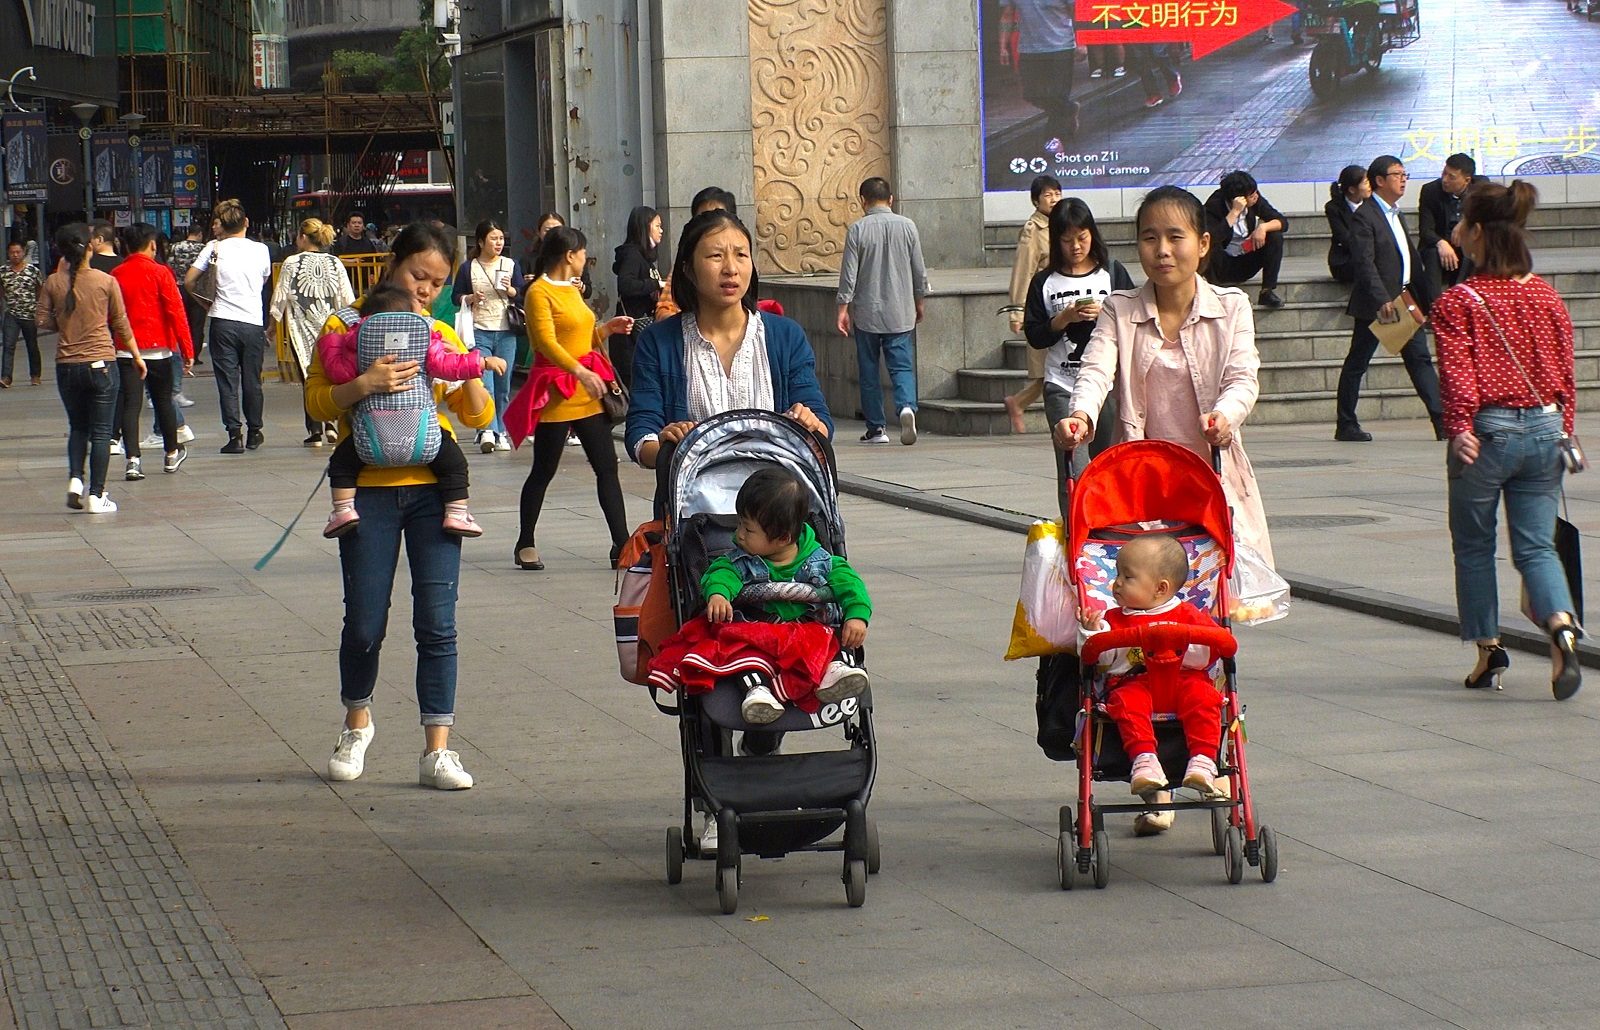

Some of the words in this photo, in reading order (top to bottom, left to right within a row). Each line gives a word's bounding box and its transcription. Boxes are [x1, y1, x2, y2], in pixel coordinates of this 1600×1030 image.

[63, 0, 96, 57] OUTLET
[1091, 1, 1238, 29] 不文明行为
[1401, 123, 1600, 162] 文明每一步
[1054, 152, 1081, 163] Shot
[1083, 154, 1099, 163] on
[1101, 151, 1119, 161] Z1i
[1054, 167, 1079, 177] vivo
[1081, 165, 1106, 176] dual
[1108, 166, 1151, 175] camera
